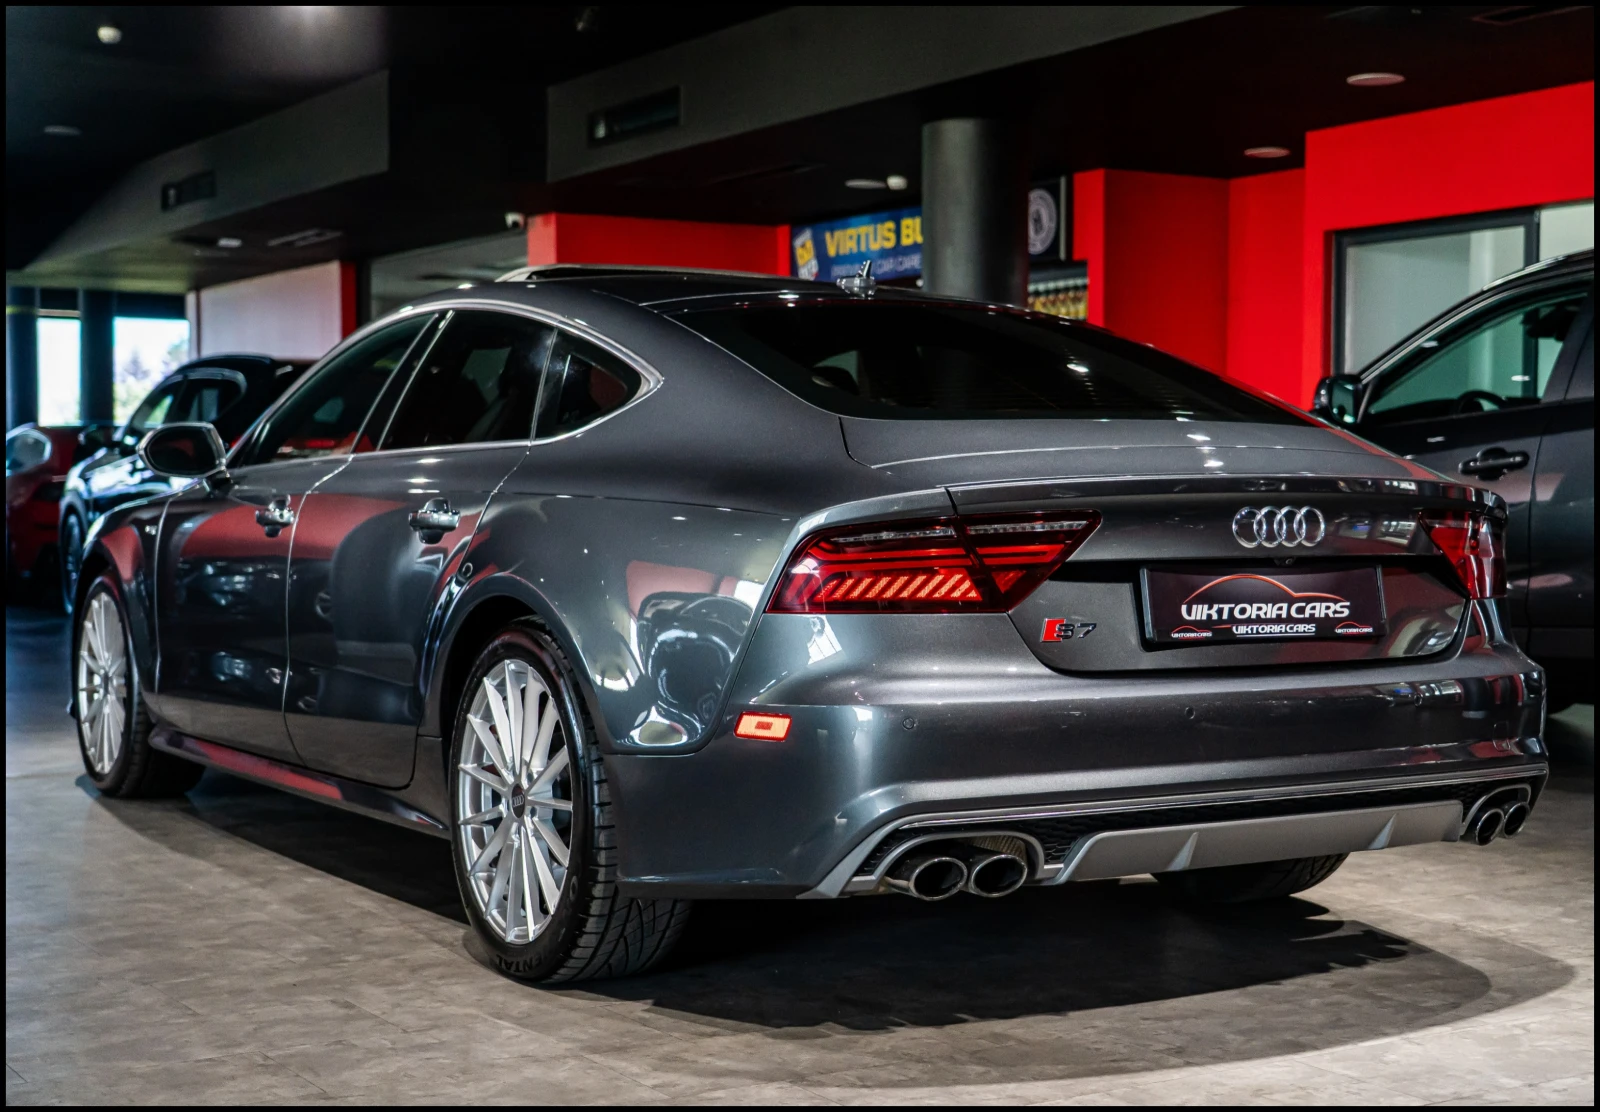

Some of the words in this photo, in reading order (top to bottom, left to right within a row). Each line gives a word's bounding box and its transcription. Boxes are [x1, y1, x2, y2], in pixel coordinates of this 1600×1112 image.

[825, 220, 896, 257] VIRTUS
[1181, 603, 1287, 621] VIKTORIA
[1290, 601, 1351, 619] CARS
[1054, 623, 1097, 639] S7
[1232, 624, 1286, 634] VIKTORIA
[1286, 623, 1316, 633] CARS
